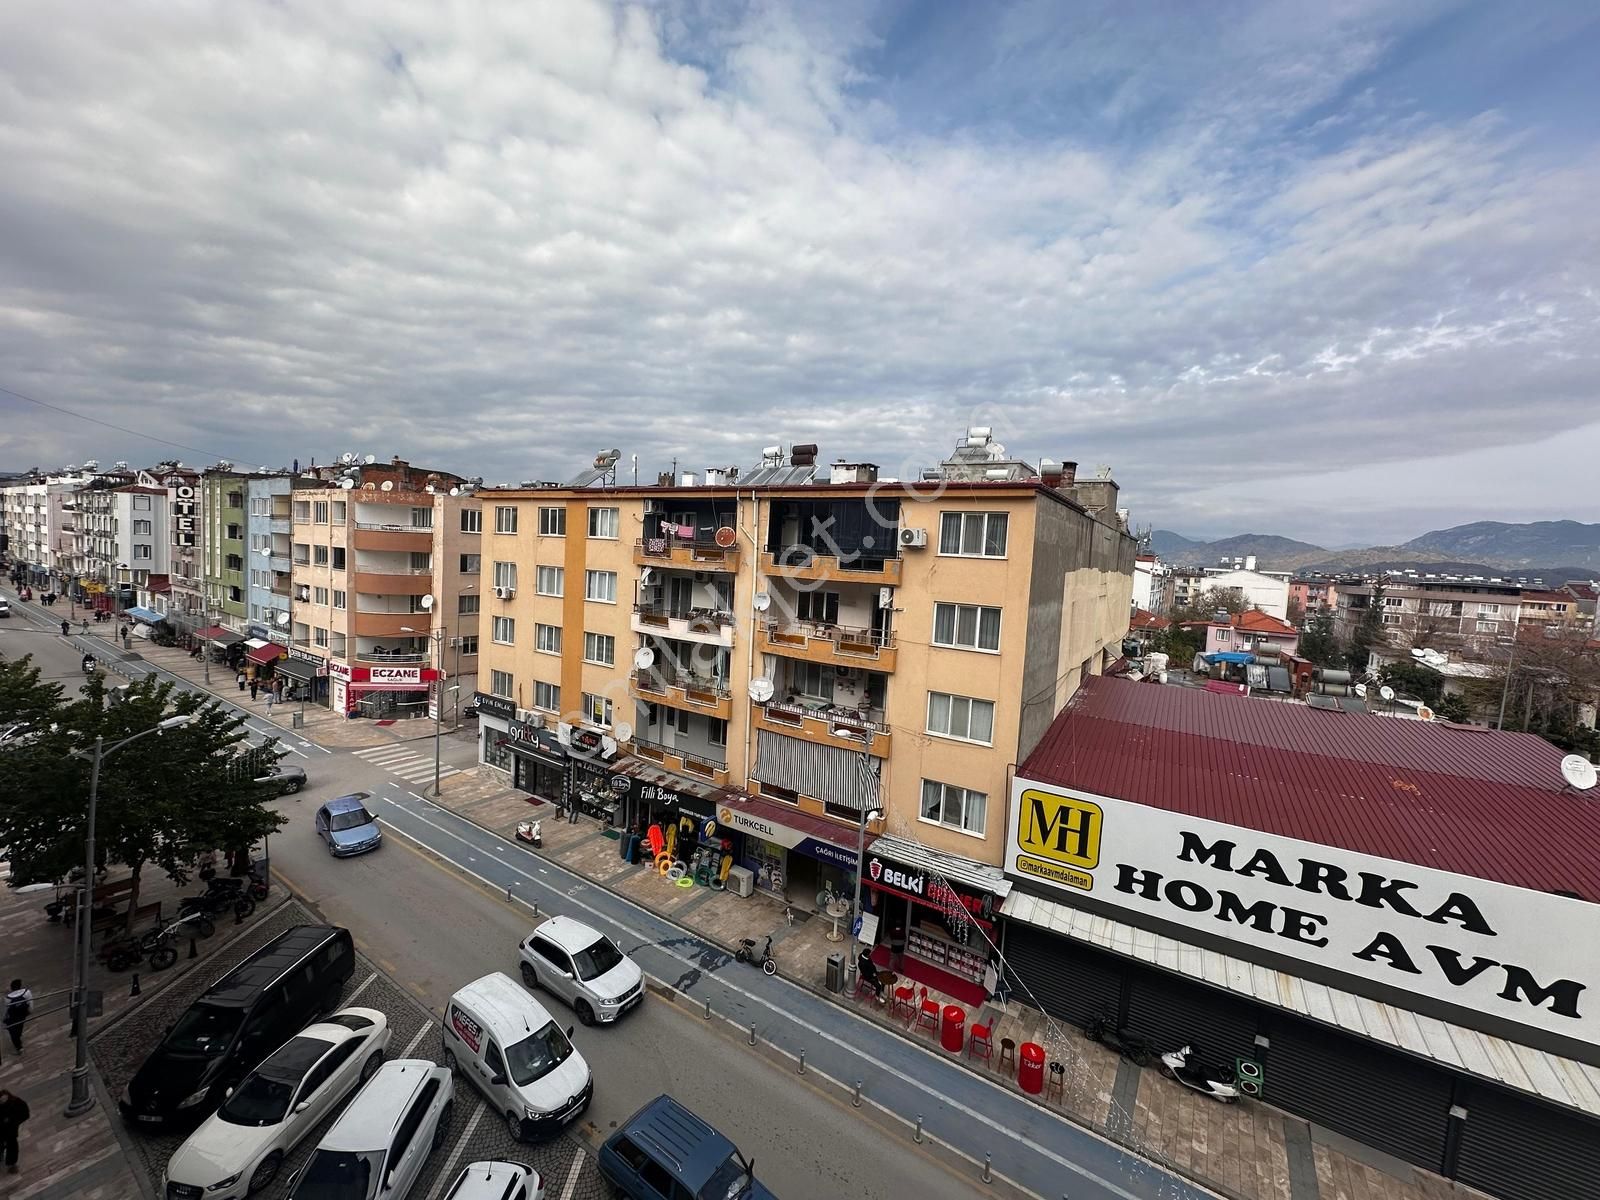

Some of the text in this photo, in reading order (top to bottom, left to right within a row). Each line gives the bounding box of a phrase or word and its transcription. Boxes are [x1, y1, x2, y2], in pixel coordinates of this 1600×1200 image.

[177, 486, 194, 546] OTEL
[372, 668, 418, 678] ECZANE
[510, 724, 539, 749] gritty
[640, 786, 679, 805] Filli Boya
[733, 814, 774, 836] TURKCELL
[815, 846, 834, 859] ÇAĞRI
[883, 868, 924, 895] BELKİ
[1177, 830, 1498, 936] MARKA
[1114, 862, 1586, 1019] HOME AVM
